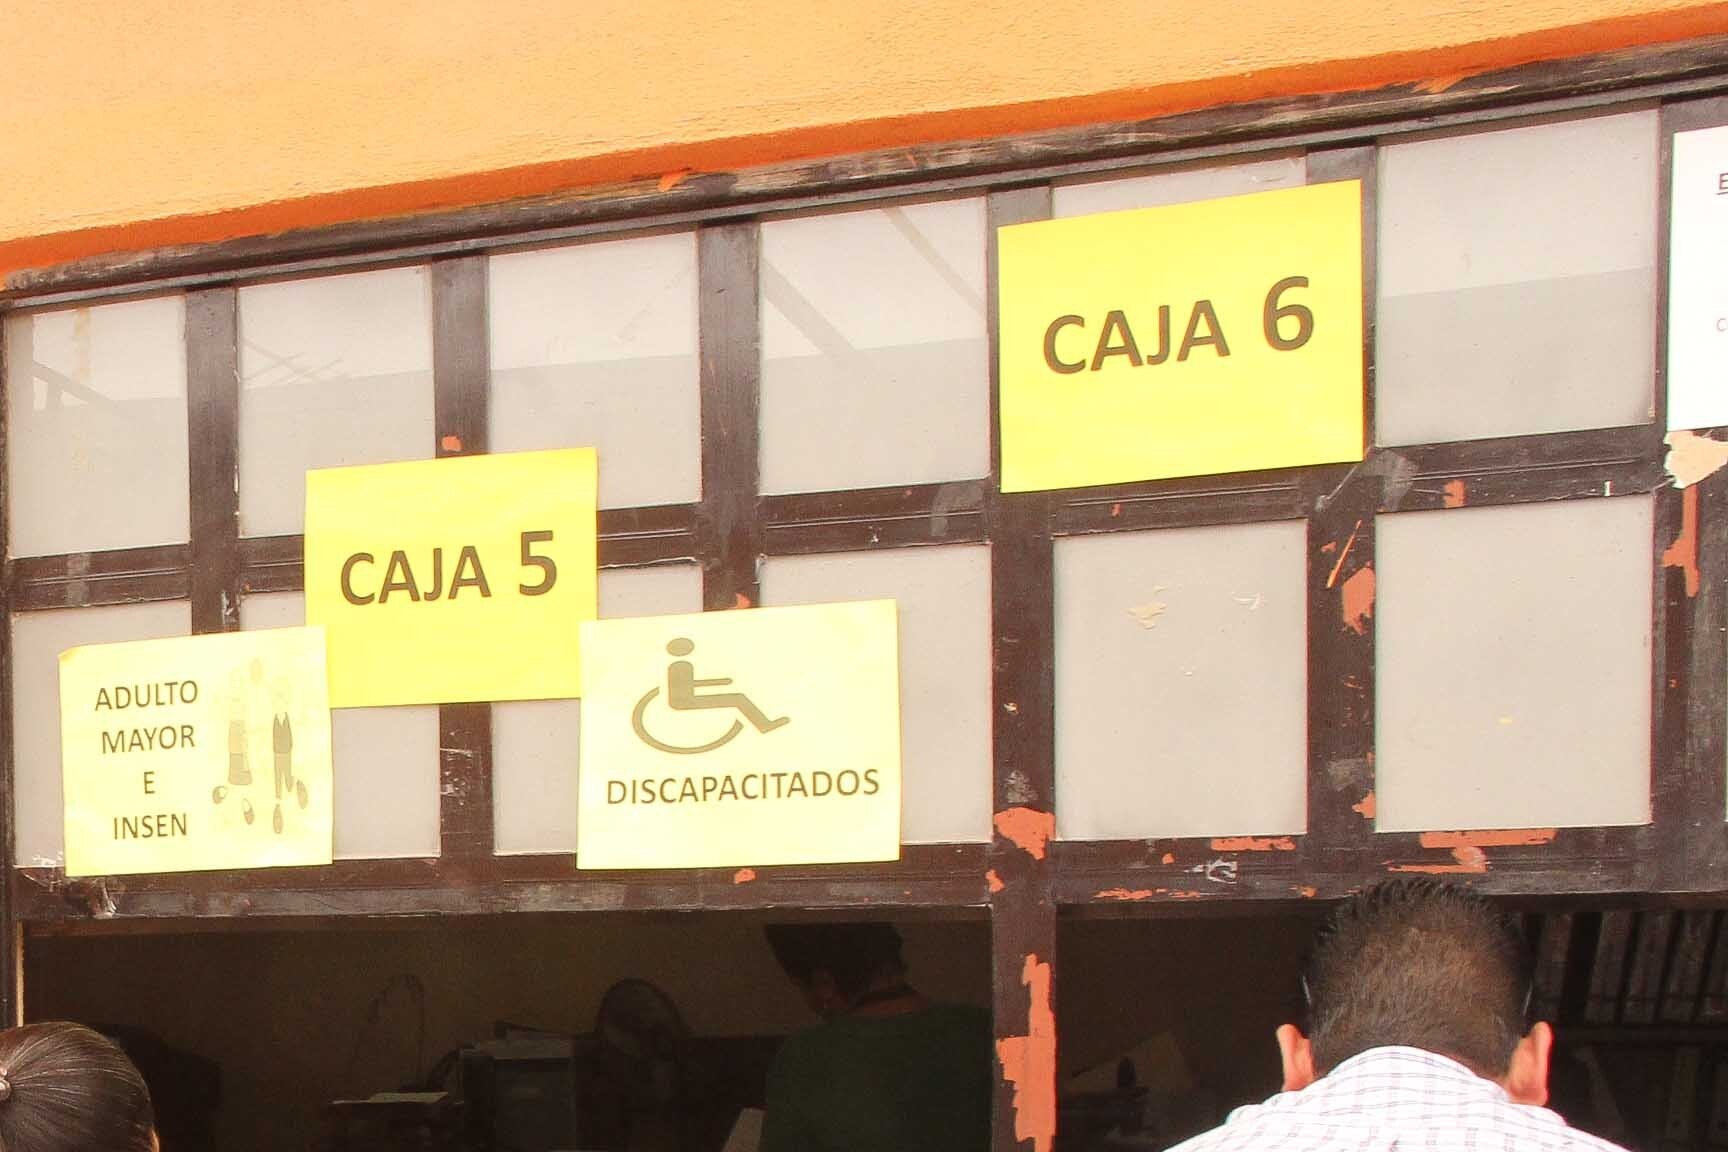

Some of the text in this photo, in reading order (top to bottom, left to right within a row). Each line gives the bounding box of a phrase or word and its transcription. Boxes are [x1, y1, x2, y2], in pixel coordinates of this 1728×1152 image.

[1042, 275, 1315, 375] CAJA 6
[340, 529, 558, 606] CAJA 5
[94, 679, 198, 712] ADULTO
[101, 724, 195, 755] MAYOR
[143, 770, 155, 795] E
[607, 768, 880, 805] DISCAPACITADOS
[113, 813, 188, 840] INSEN
